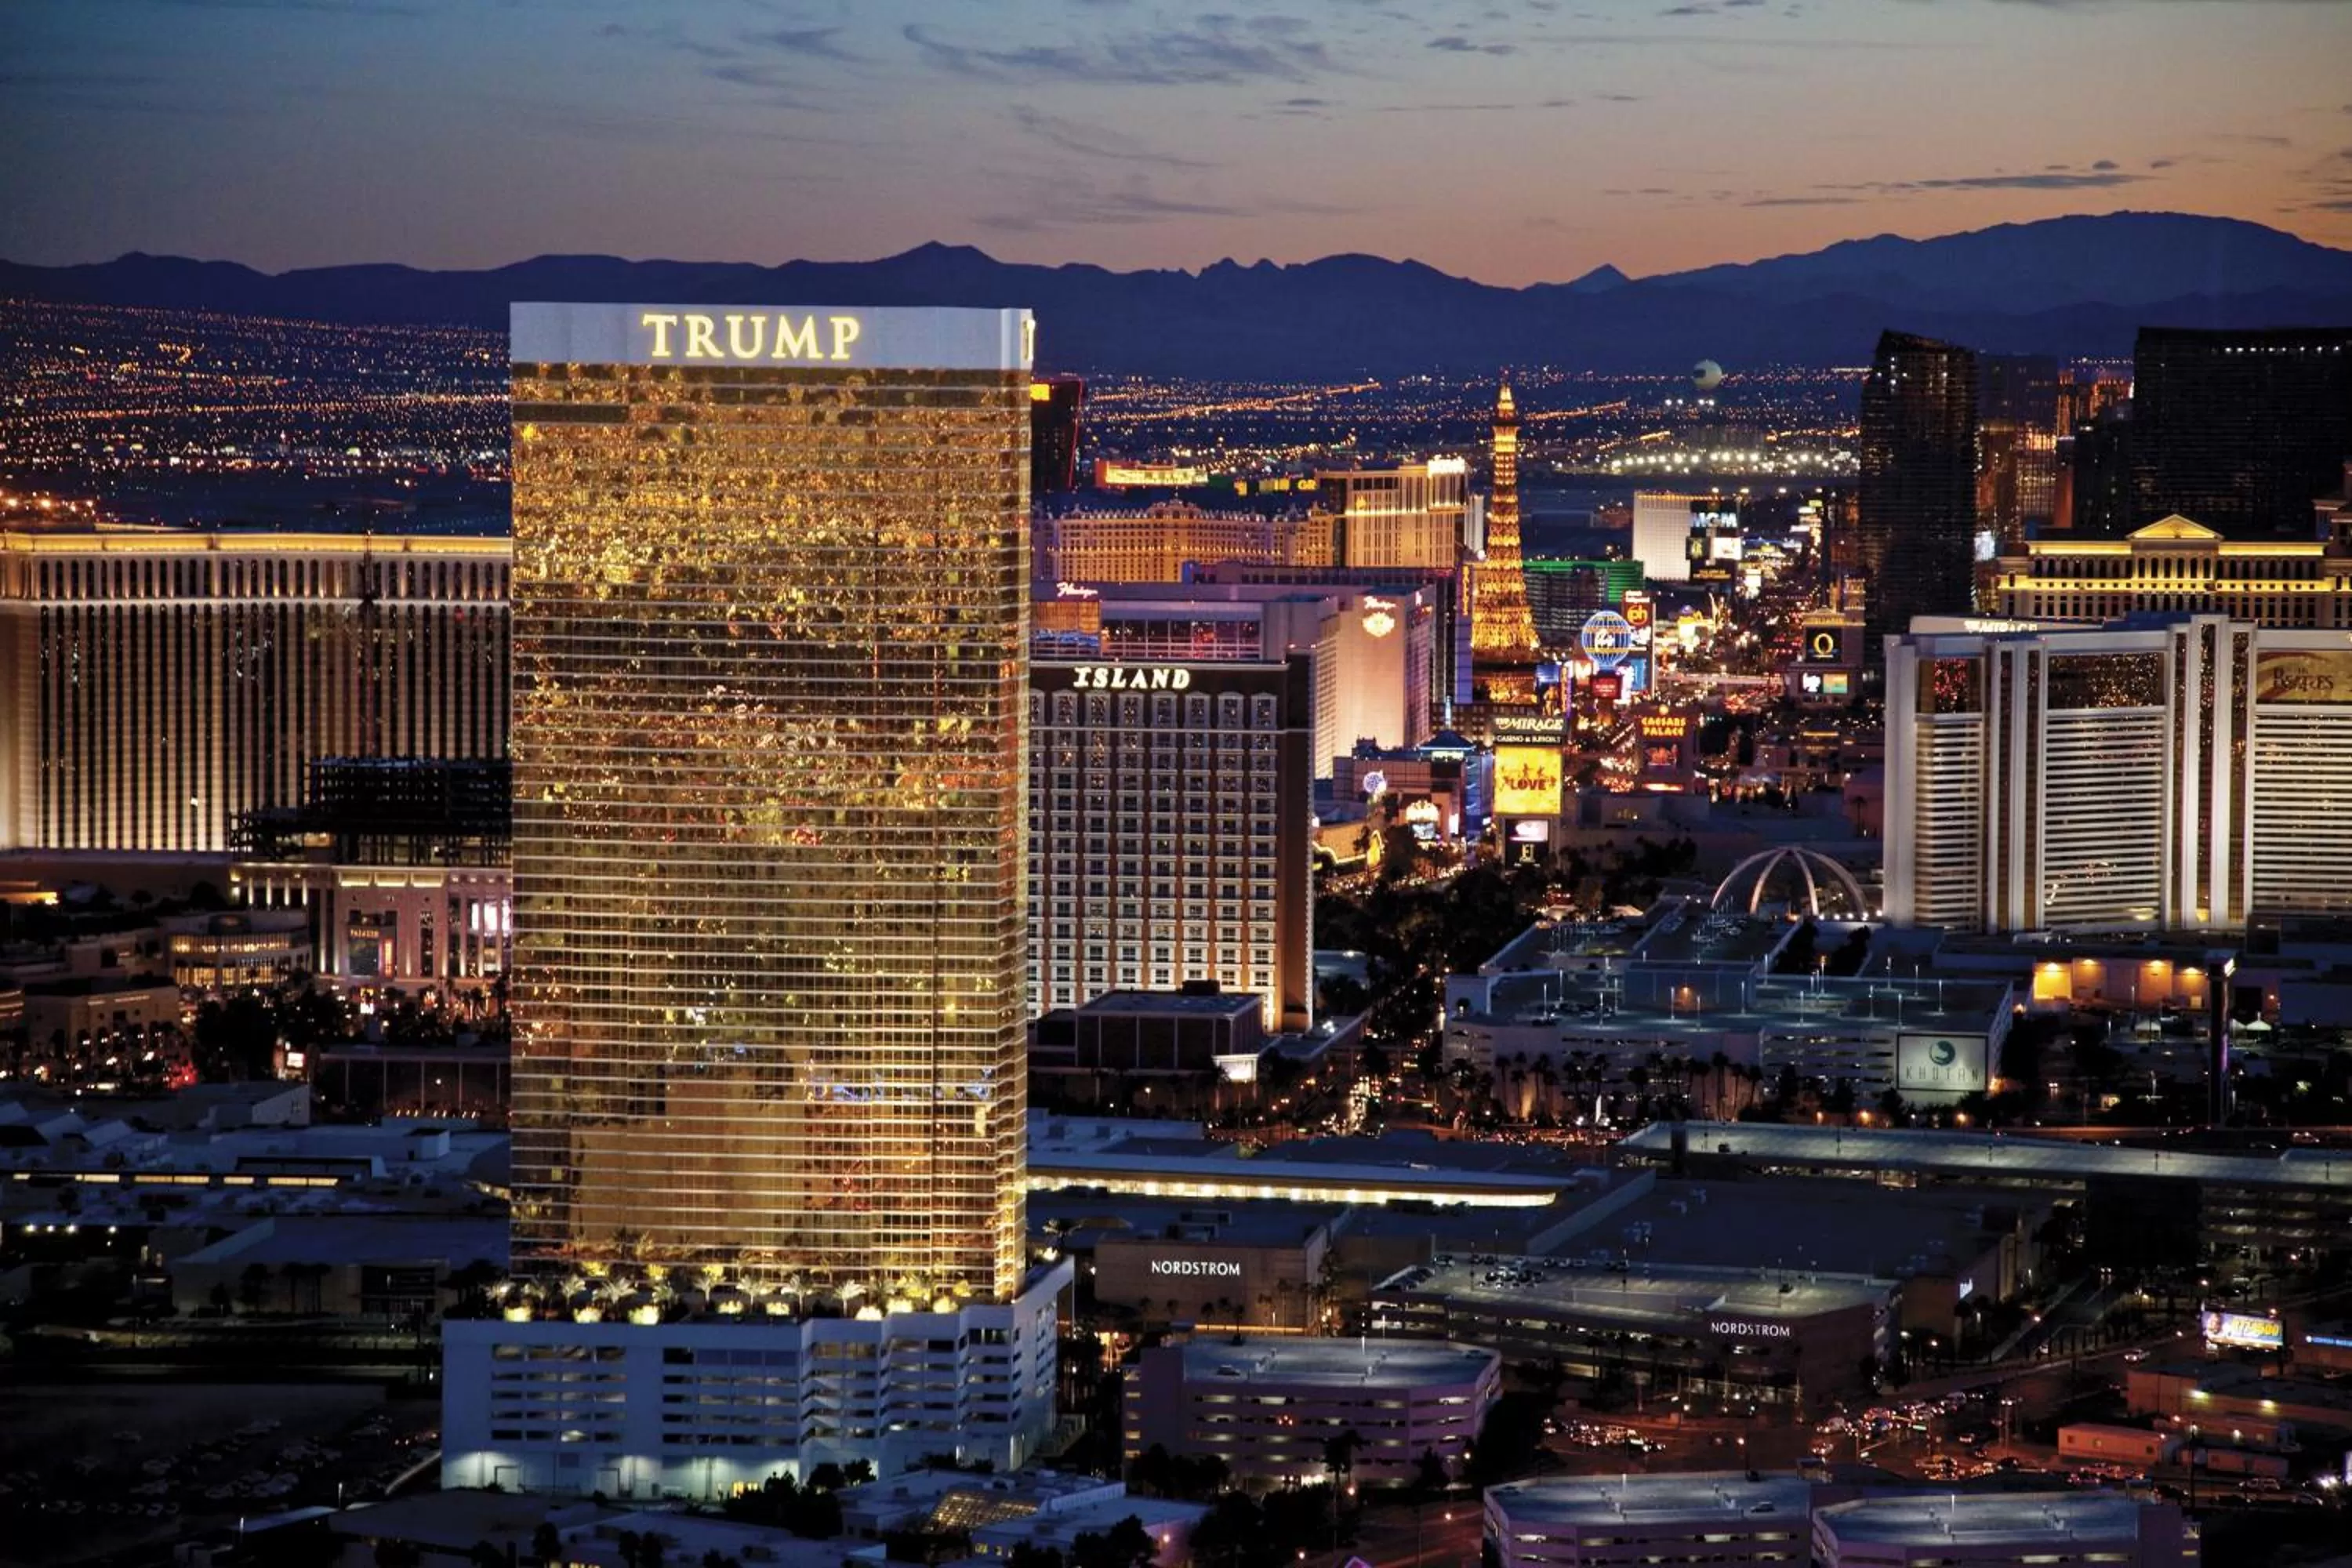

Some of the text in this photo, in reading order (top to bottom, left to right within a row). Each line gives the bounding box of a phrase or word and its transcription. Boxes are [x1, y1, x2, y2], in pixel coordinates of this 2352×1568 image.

[642, 314, 860, 358] TRUMP
[1073, 667, 1190, 689] ISLAND
[1508, 717, 1563, 731] MIRAGE
[1641, 717, 1686, 726] CAESARS
[1643, 727, 1684, 736] PALACE
[1511, 777, 1547, 791] LOVE
[1906, 1065, 1980, 1081] KHOTAN
[1151, 1260, 1240, 1276] NORDSTROM
[1711, 1322, 1791, 1337] NORDSTROM
